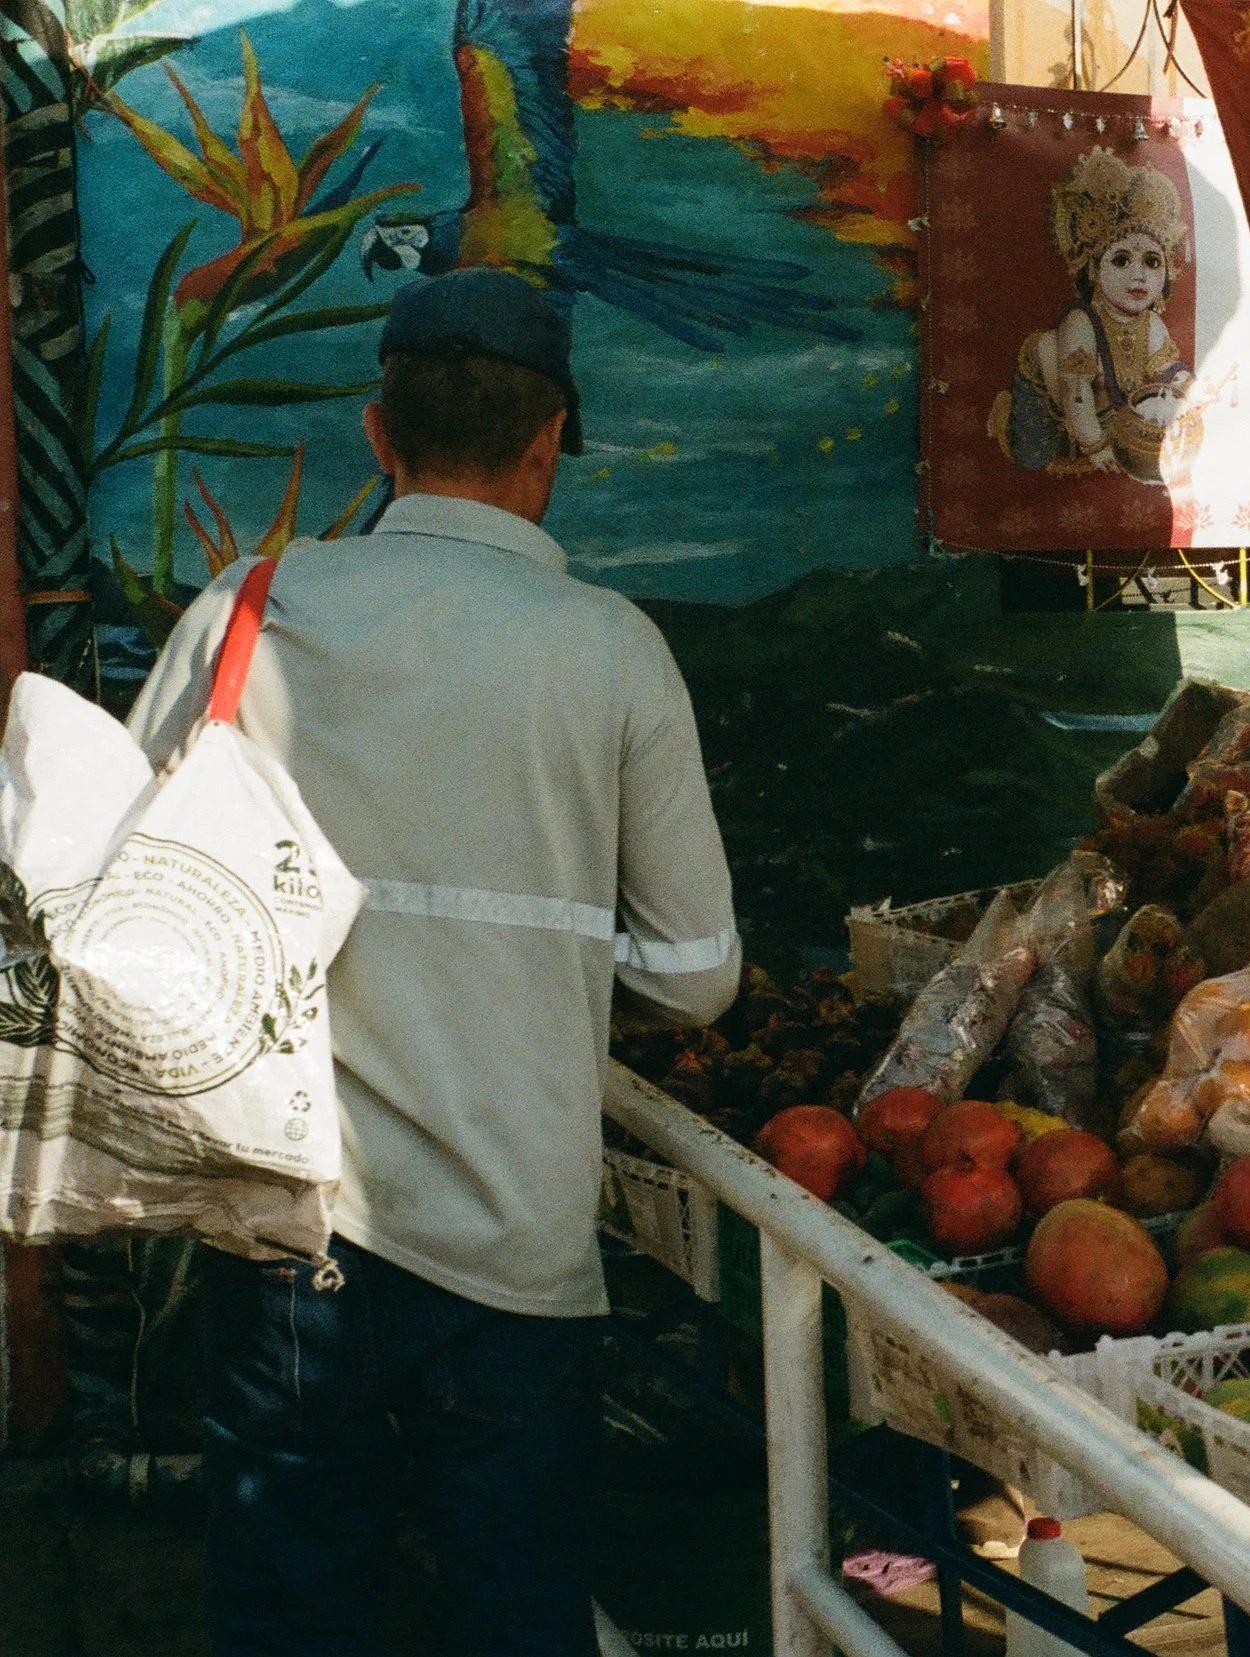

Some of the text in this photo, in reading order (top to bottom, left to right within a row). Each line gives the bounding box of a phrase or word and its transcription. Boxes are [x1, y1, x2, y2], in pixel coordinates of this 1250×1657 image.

[134, 871, 164, 881] ECO
[144, 855, 248, 918] NATURALEZA
[250, 930, 266, 986] MEDIO
[155, 1063, 199, 1080] VIDA
[629, 1630, 689, 1649] OSITE
